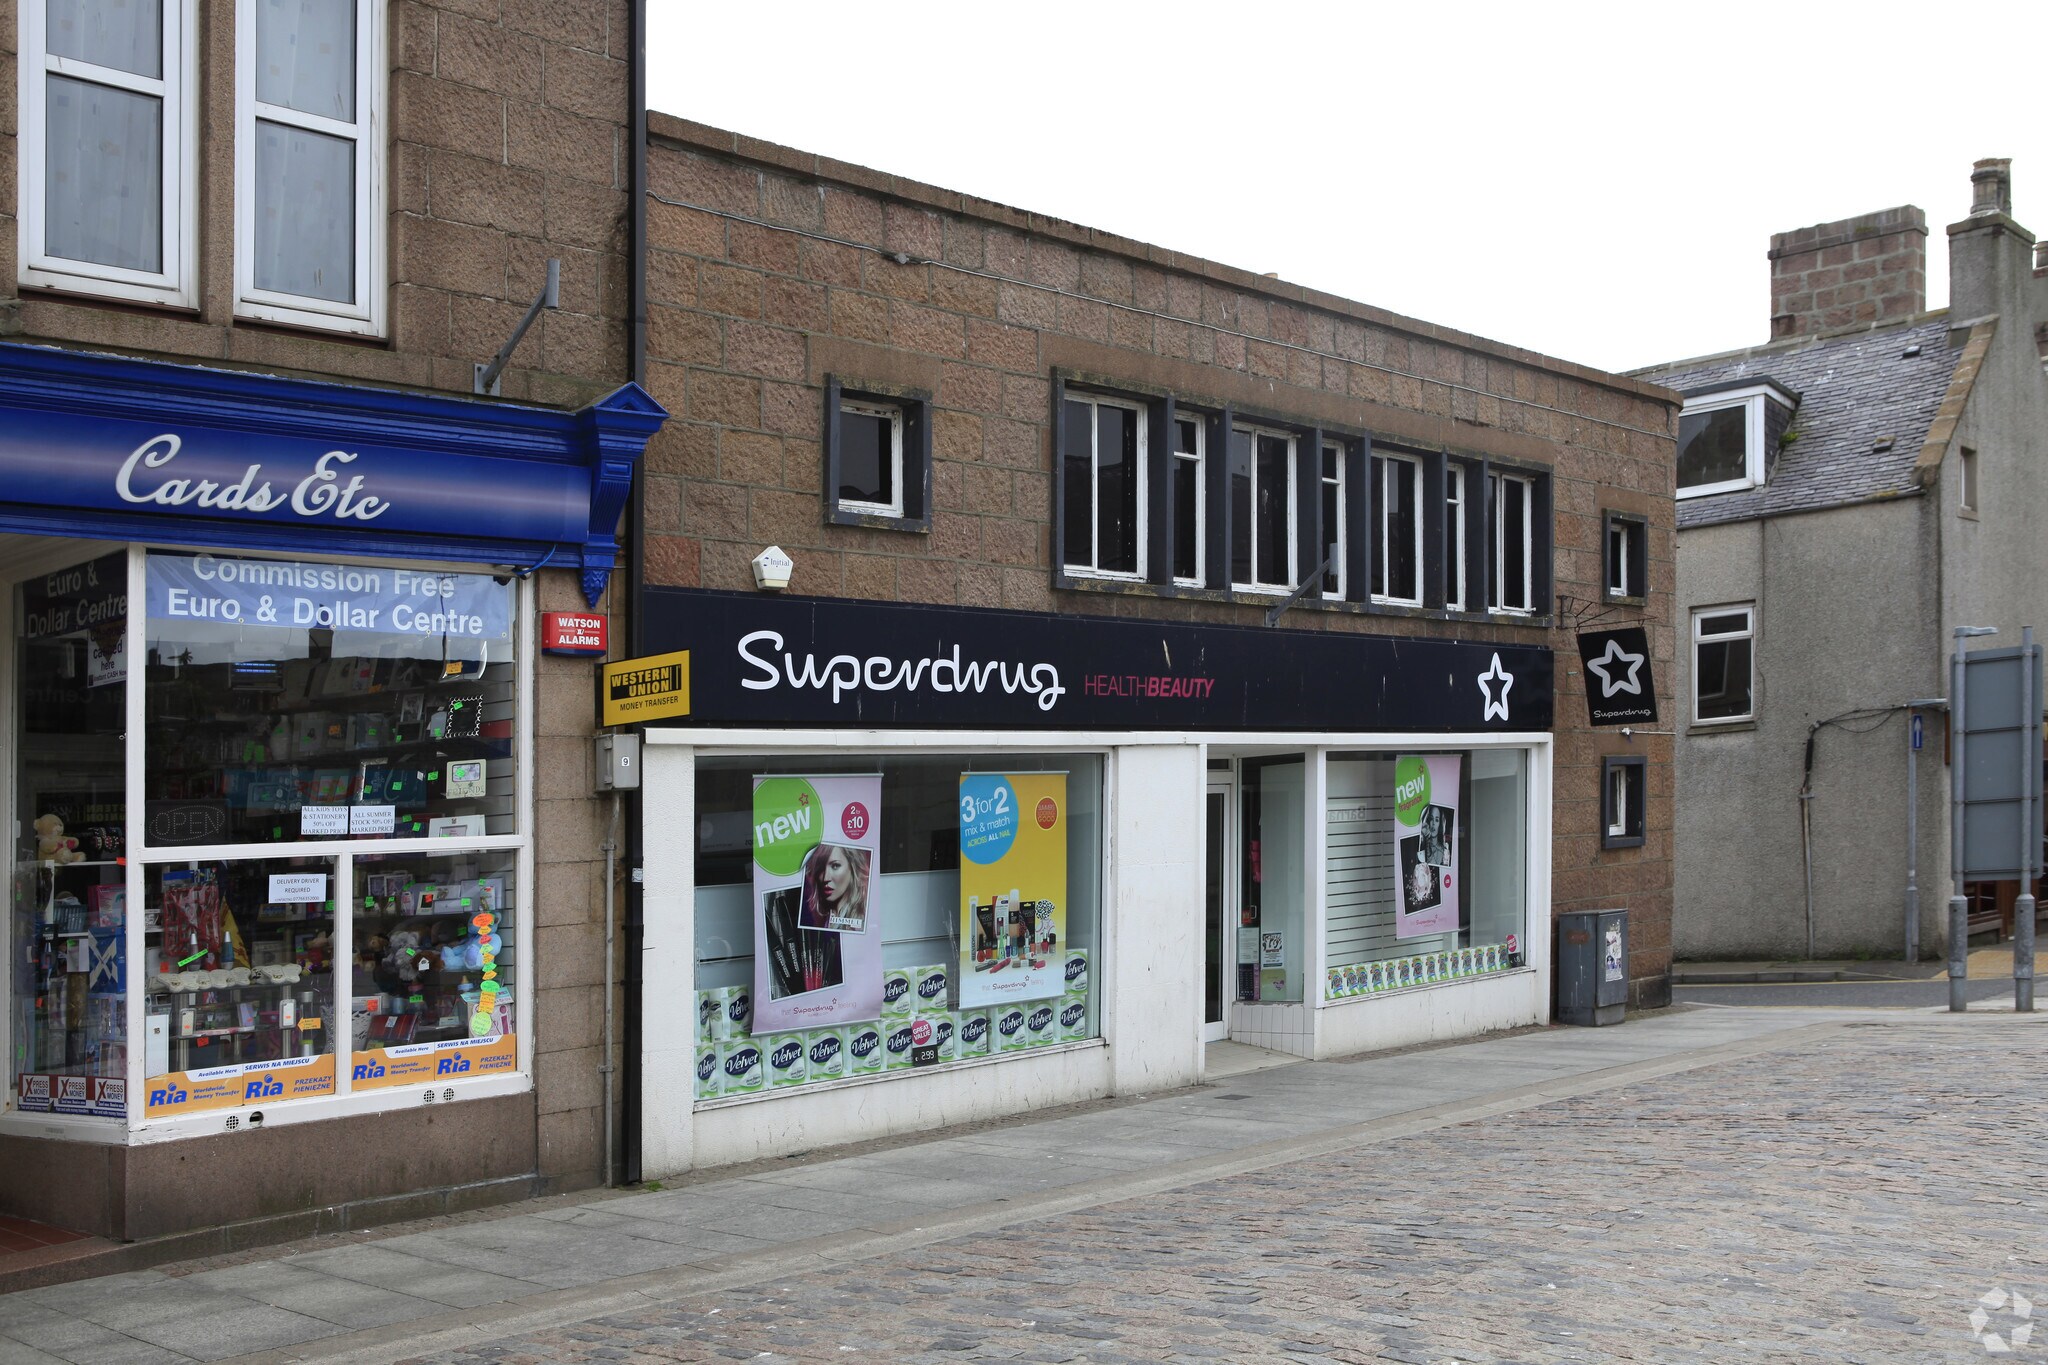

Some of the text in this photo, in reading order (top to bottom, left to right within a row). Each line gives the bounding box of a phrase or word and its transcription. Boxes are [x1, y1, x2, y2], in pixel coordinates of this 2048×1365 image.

[115, 434, 390, 520] Cards Etc
[771, 558, 790, 566] Initial
[47, 561, 99, 598] Euro &
[193, 553, 455, 598] Commission Free
[28, 608, 70, 638] Dollar
[76, 594, 127, 626] Centre
[168, 588, 483, 634] Euro & Dollar Centre
[558, 617, 600, 629] WATSON
[558, 634, 600, 646] ALARMS
[101, 660, 115, 671] here
[737, 630, 1066, 711] Superdrug
[107, 671, 118, 679] CASH
[611, 667, 669, 688] WESTERN
[629, 680, 669, 697] UNION
[620, 696, 679, 712] MONEY TRANSFER
[1593, 708, 1652, 719] Superdrug
[623, 758, 629, 766] 9
[1396, 774, 1424, 804] new
[850, 806, 856, 815] 2
[961, 786, 1010, 823] 3 for 2
[156, 811, 219, 835] OPEN
[755, 806, 811, 848] new
[847, 816, 864, 829] £10
[965, 816, 1010, 837] mix & match
[967, 836, 987, 848] ACROSS
[988, 833, 999, 842] ALL
[884, 983, 907, 997] Velvet
[919, 979, 945, 995] Velvet
[992, 982, 1027, 990] Superdrug
[793, 1004, 834, 1014] Superdrug
[1061, 1008, 1084, 1022] Velvet
[1000, 1015, 1023, 1033] Velvet
[1029, 1011, 1052, 1028] Velvet
[913, 1024, 929, 1034] GREAT
[914, 1030, 931, 1040] VALUE
[937, 1026, 952, 1040] elvet
[962, 1023, 987, 1039] Velvet
[437, 1041, 459, 1049] SERWIS
[470, 1037, 494, 1045] MIEJSCU
[851, 1036, 878, 1054] Velvet
[888, 1033, 912, 1051] Velve
[480, 1054, 513, 1063] PRZEKAZY
[772, 1046, 801, 1065] Velvet
[811, 1042, 840, 1060] Velvet
[921, 1050, 935, 1060] 2.99
[245, 1063, 270, 1071] SERWIS
[282, 1058, 310, 1066] MIEJSCU
[352, 1057, 386, 1081] Ria
[437, 1051, 471, 1075] Ria
[726, 1052, 758, 1072] Velvet
[245, 1074, 284, 1099] Ria
[294, 1075, 332, 1085] PRZEKAZY
[69, 1090, 85, 1098] MONEY
[149, 1082, 187, 1107] Ria
[193, 1085, 225, 1094] Worldwide
[215, 1090, 240, 1098] Transfer
